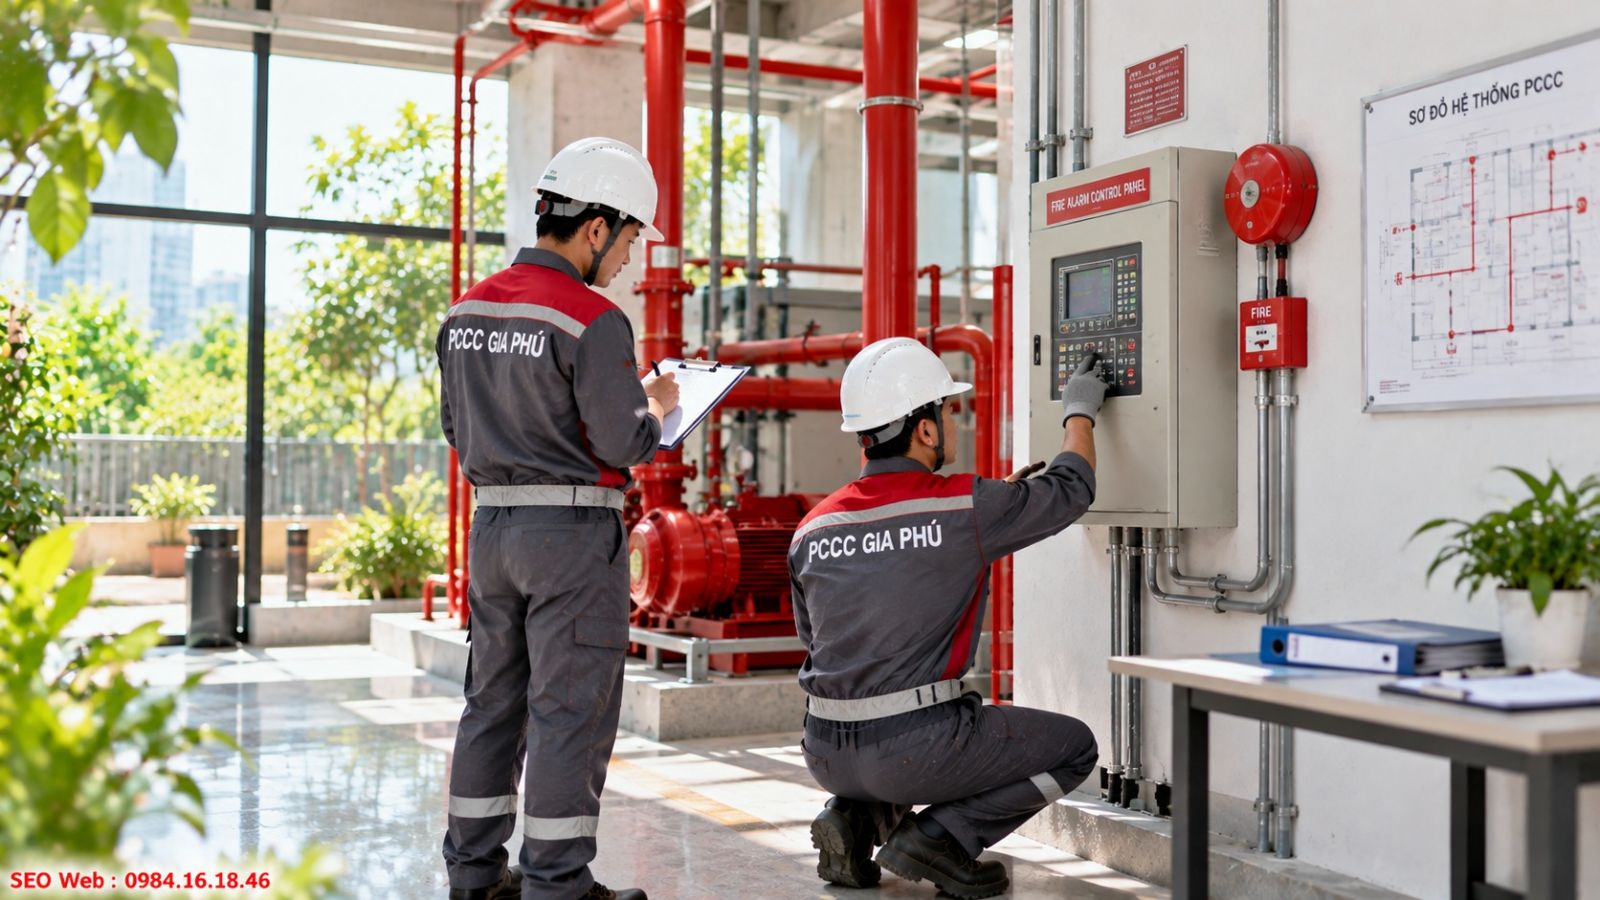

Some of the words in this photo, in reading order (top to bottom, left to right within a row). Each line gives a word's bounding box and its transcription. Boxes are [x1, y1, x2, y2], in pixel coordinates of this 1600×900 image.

[1524, 71, 1564, 96] PCCC
[1090, 185, 1122, 204] CONTROL
[1251, 305, 1272, 320] FIRE
[448, 327, 485, 352] PCCC
[488, 331, 508, 353] GIA
[510, 330, 546, 358] PHÚ
[808, 534, 857, 563] PCCC
[862, 530, 895, 554] GIA
[900, 518, 942, 550] PHÚ
